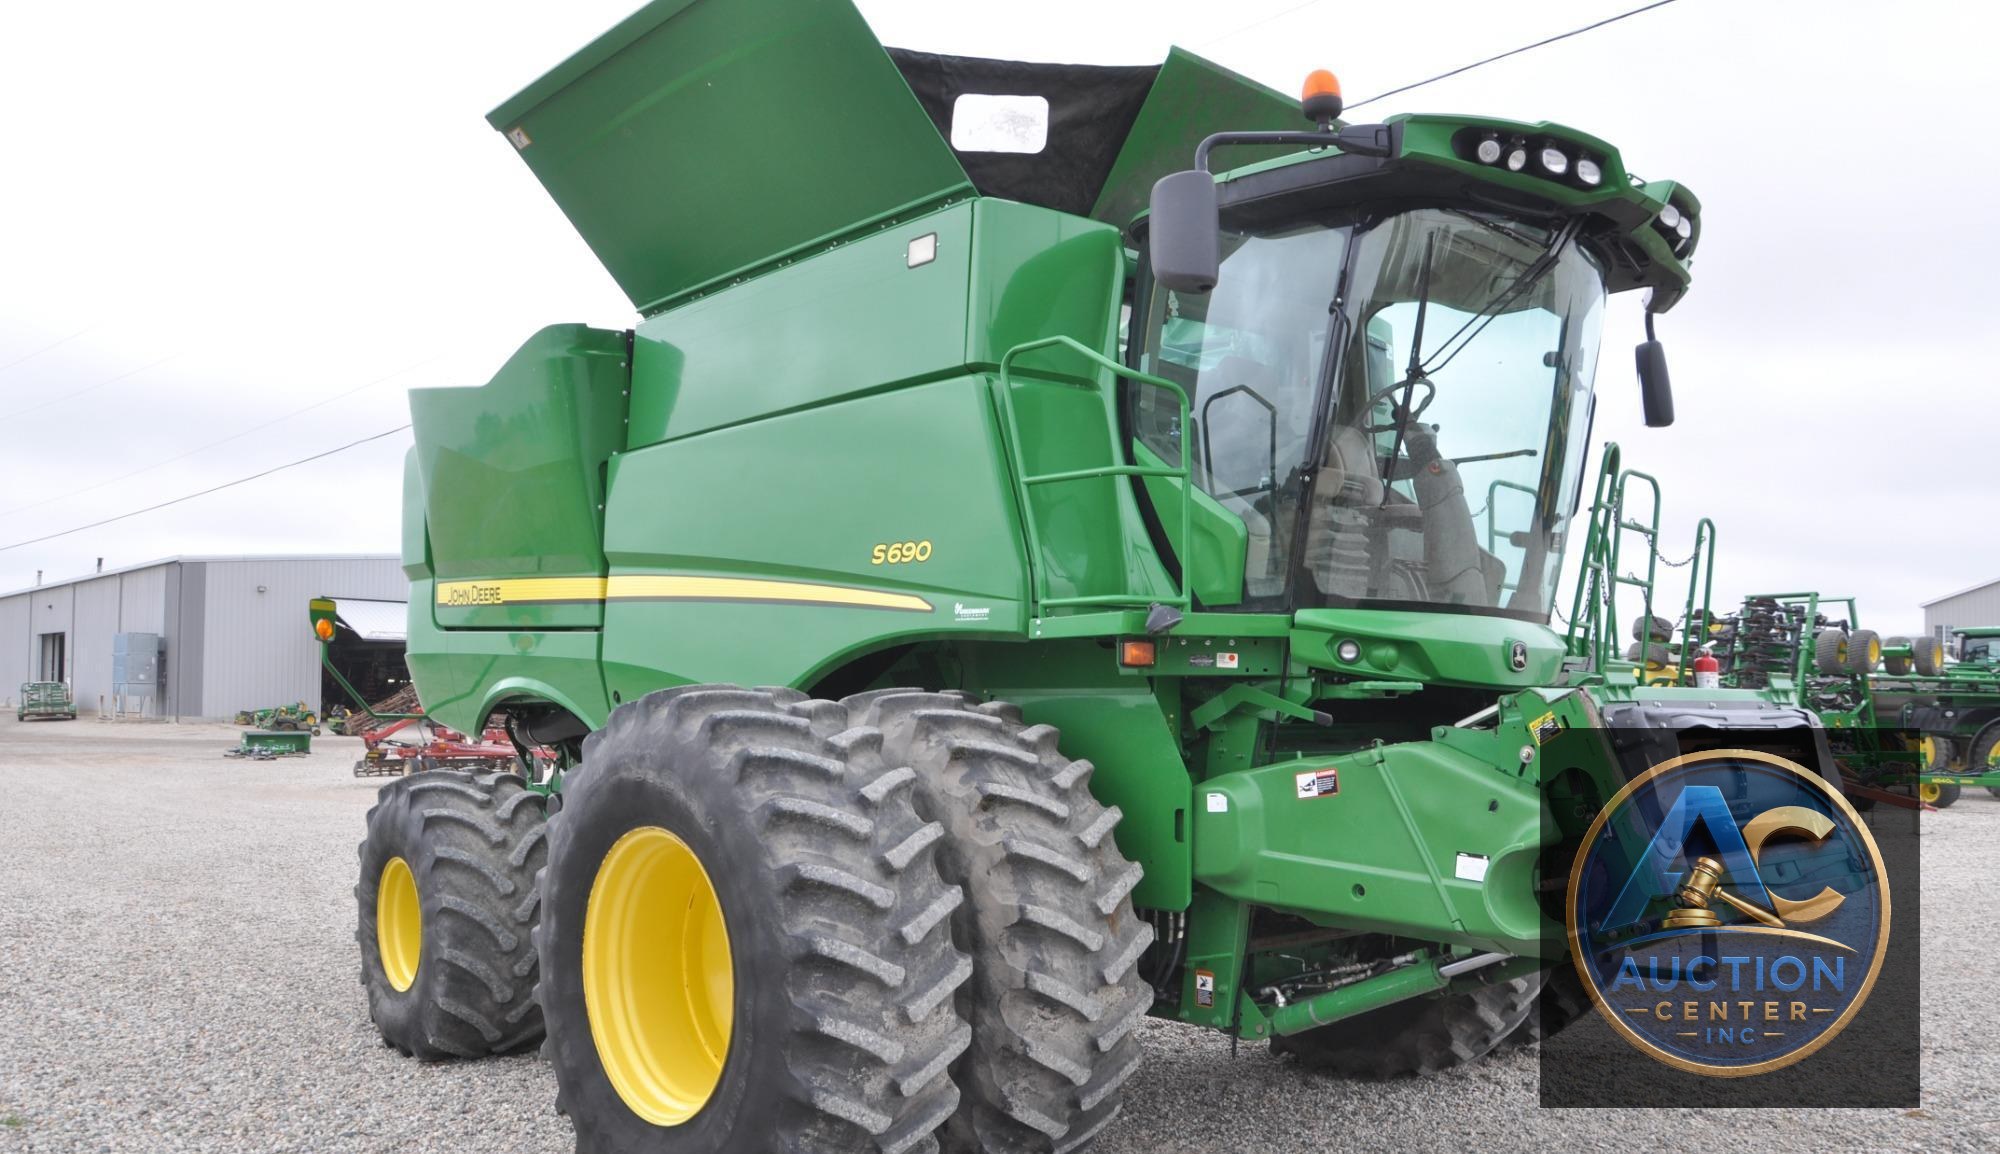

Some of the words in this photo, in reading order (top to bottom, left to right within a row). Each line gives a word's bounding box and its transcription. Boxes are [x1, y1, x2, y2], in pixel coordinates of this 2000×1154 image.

[871, 540, 932, 565] S690
[447, 586, 470, 604] JOHN
[471, 584, 502, 602] DEERE
